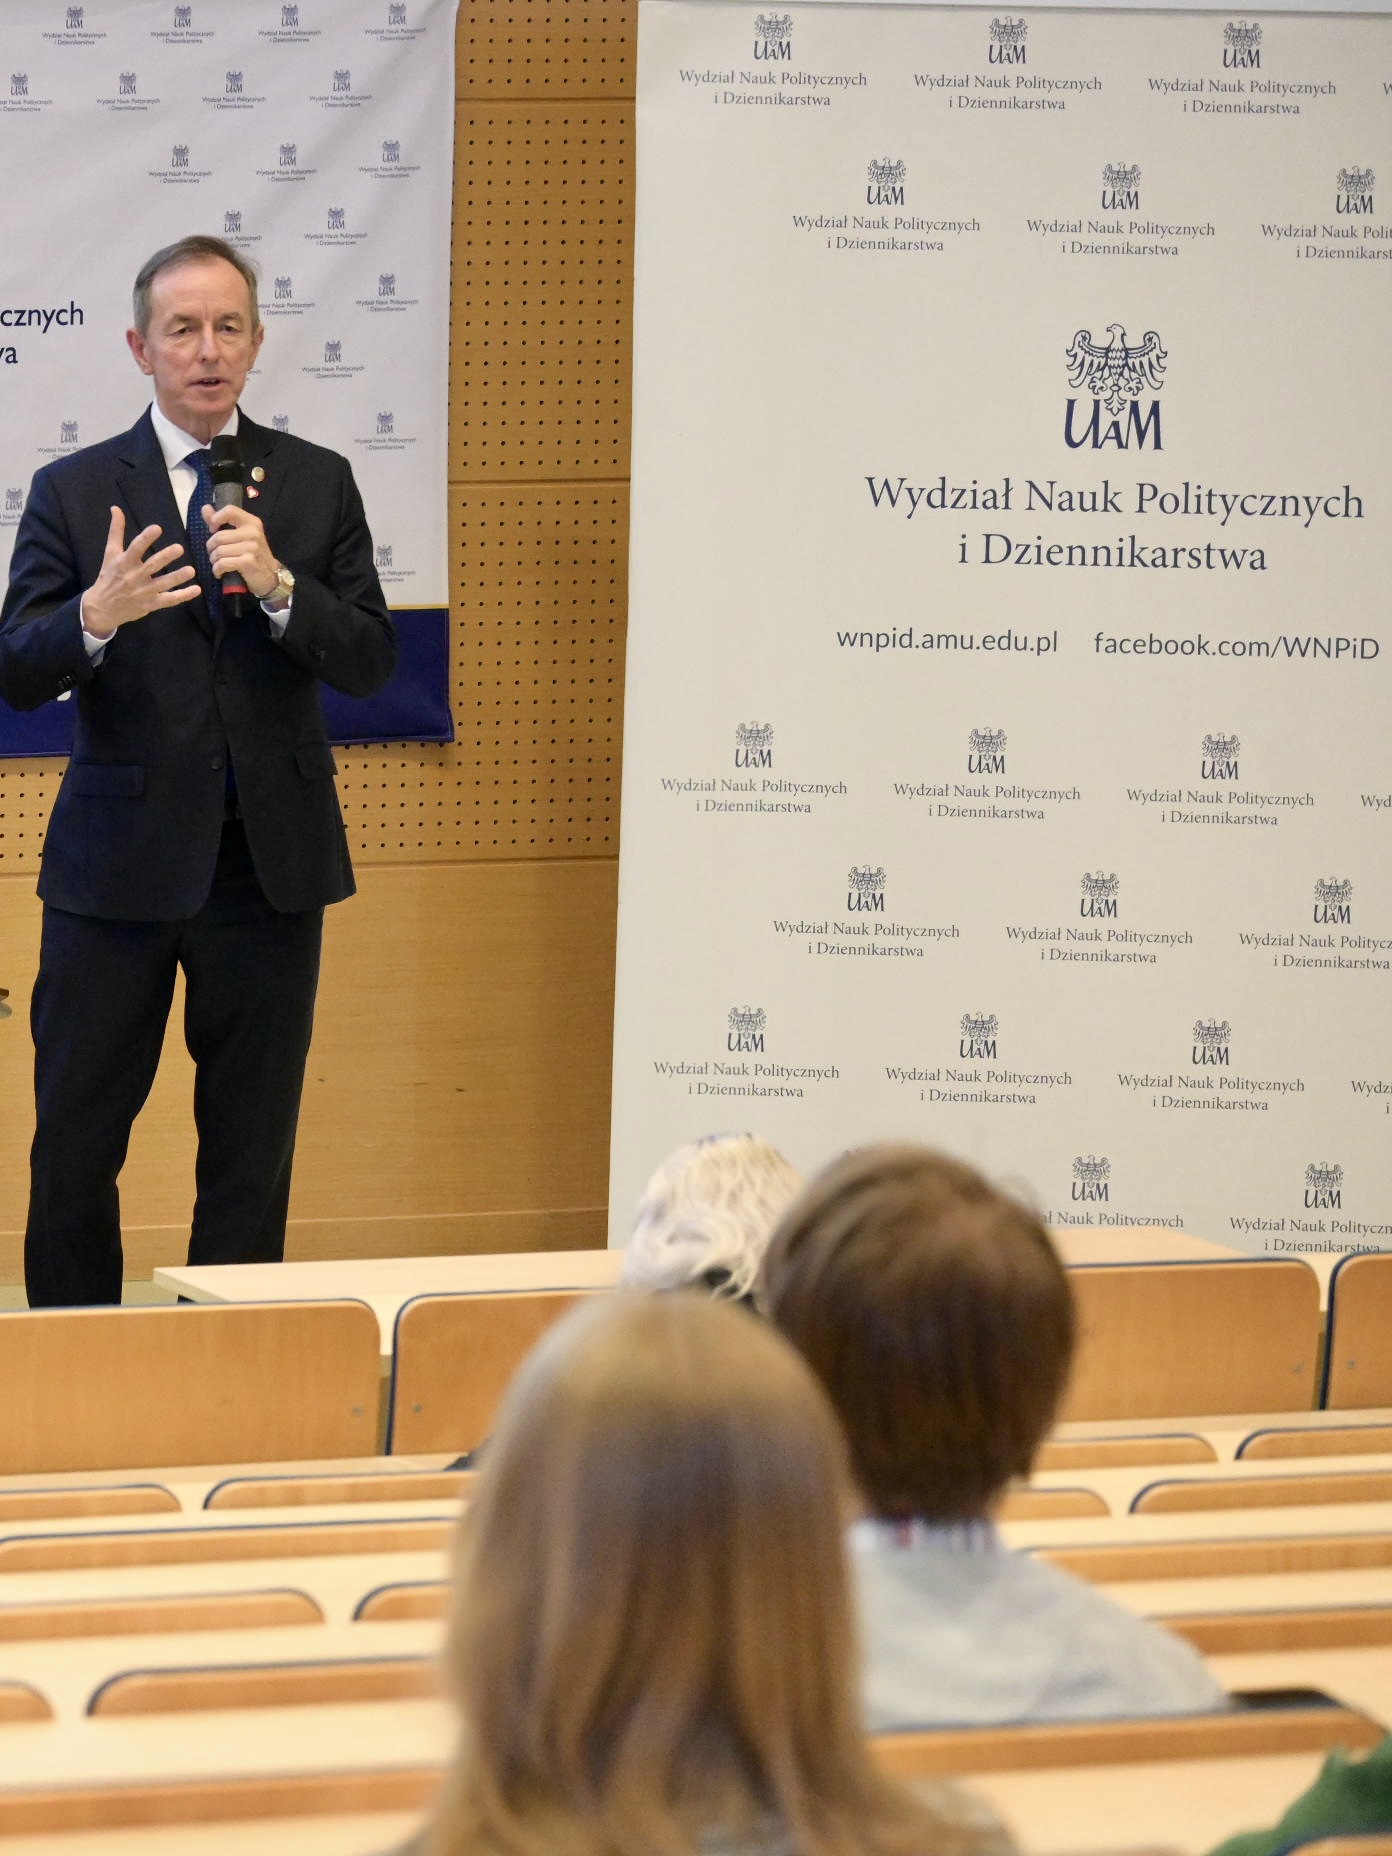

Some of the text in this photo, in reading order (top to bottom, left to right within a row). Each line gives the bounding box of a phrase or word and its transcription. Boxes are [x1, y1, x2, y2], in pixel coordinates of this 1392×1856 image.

[679, 69, 866, 89] Wydział Nauk Politycznych
[914, 74, 1102, 93] Wydział Nauk Politycznych
[1148, 78, 1336, 98] Wydział Nauk Politycznych
[723, 92, 830, 106] Dziennikarstwa
[959, 96, 1065, 110] Dziennikarstwa
[1192, 100, 1300, 114] Dziennikarstwa
[793, 215, 979, 235] Wydział Nauk Politycznych
[1026, 219, 1215, 239] Wydział Nauk Politycznych
[1261, 224, 1316, 240] Wydział
[1322, 224, 1358, 238] Nauk
[836, 237, 943, 251] Dziennikarstwa
[1071, 241, 1178, 255] Dziennikarstwa
[1305, 245, 1392, 259] Dziennikarst
[1064, 398, 1164, 450] UAM
[865, 477, 1365, 528] Wydział Nauk Politycznych
[958, 533, 1268, 571] i Dziennikarstwa
[836, 627, 1380, 660] wnpid.amu.edu.pl facebook.com/WNPiD
[661, 778, 847, 798] Wydział Nauk Politycznych
[893, 783, 1080, 803] Wydział Nauk Politycznych
[704, 799, 811, 813] Dziennikarstwa
[1127, 789, 1314, 809] Wydział Nauk Politycznych
[937, 805, 1044, 819] Dziennikarstwa
[1170, 811, 1278, 825] Dziennikarstwa
[773, 920, 959, 941] Wydział Nauk Politycznych
[1006, 927, 1192, 947] Wydział Nauk Politycznych
[817, 942, 924, 957] Dziennikarstwa
[1240, 933, 1392, 952] Wydział Nauk Politycz
[1050, 948, 1156, 963] Dziennikarstwa
[1282, 954, 1390, 969] Dziennikarstwa
[654, 1062, 839, 1082] Wydział Nauk Politycznych
[885, 1067, 1072, 1088] Wydział Nauk Politycznych
[698, 1083, 804, 1097] Dziennikarstwa
[1118, 1074, 1304, 1095] Wydział Nauk Politycznych
[1351, 1081, 1392, 1097] Wydzi
[930, 1089, 1036, 1104] Dziennikarstwa
[1161, 1096, 1268, 1110] Dziennikarstwa
[1057, 1212, 1093, 1224] Nauk
[1230, 1217, 1392, 1238] Wydział Nauk Polityczn
